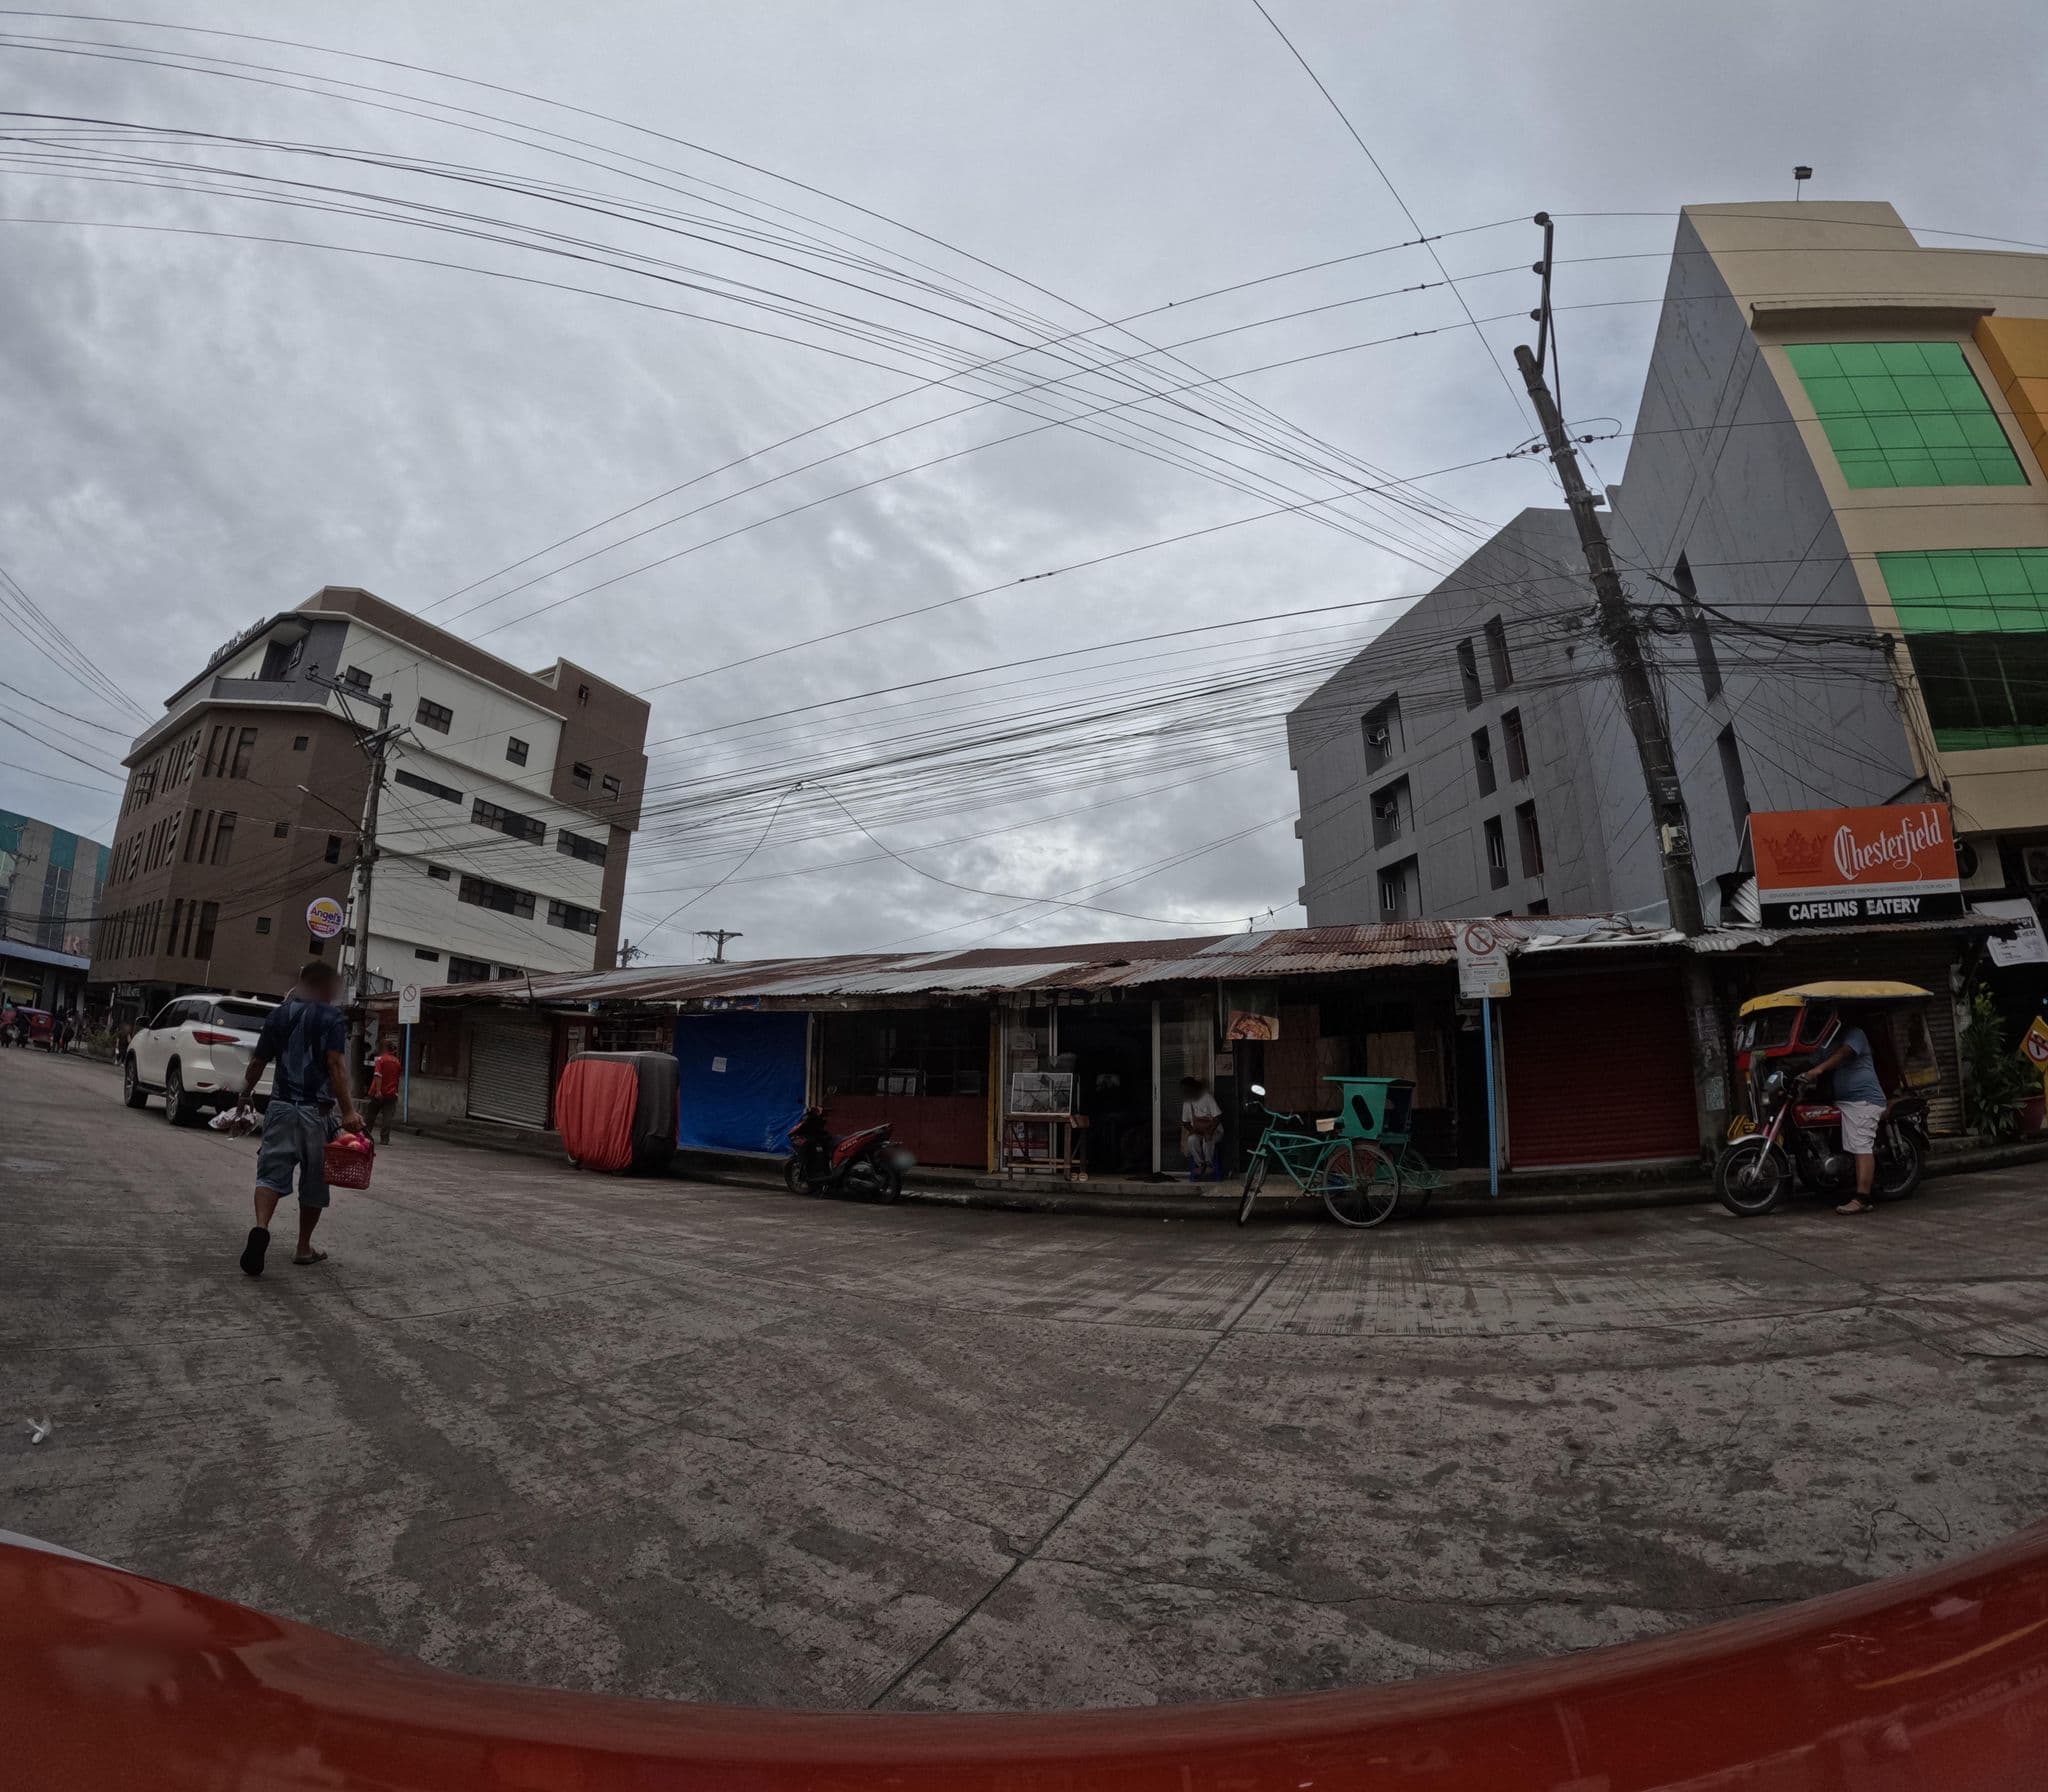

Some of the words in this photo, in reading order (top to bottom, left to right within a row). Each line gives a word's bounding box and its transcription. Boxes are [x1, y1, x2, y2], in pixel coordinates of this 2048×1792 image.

[1833, 808, 1943, 881] Chesterfield
[311, 906, 341, 923] Angel's
[1789, 900, 1859, 921] CAFELINS
[1866, 897, 1921, 916] EATERY
